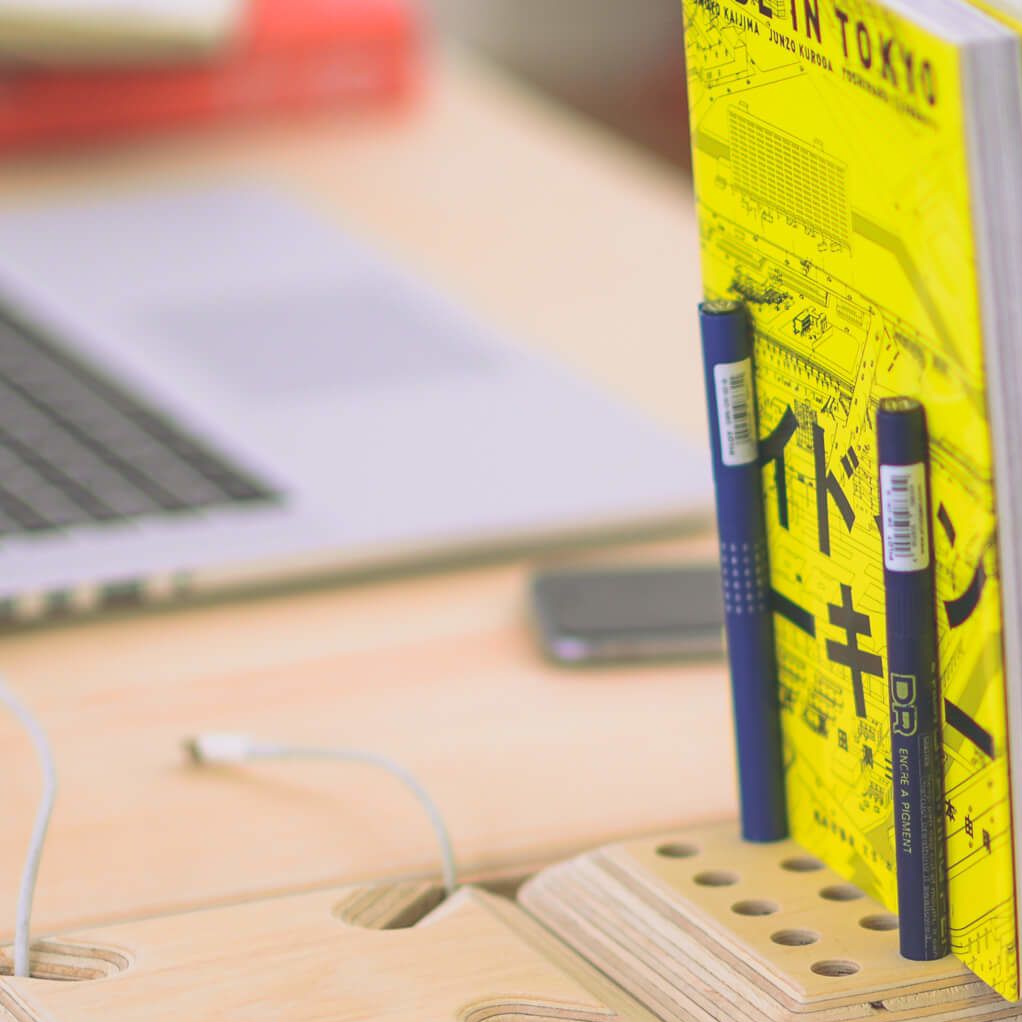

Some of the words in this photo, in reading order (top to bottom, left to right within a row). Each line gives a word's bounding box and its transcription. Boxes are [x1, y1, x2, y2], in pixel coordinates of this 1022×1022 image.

[723, 7, 760, 36] KAIJIMA
[768, 28, 796, 53] JUNZO
[790, 0, 822, 44] IN
[834, 6, 938, 107] TOKYO
[898, 747, 910, 786] ENCRE
[900, 788, 910, 798] A
[900, 801, 913, 854] PIGMENT
